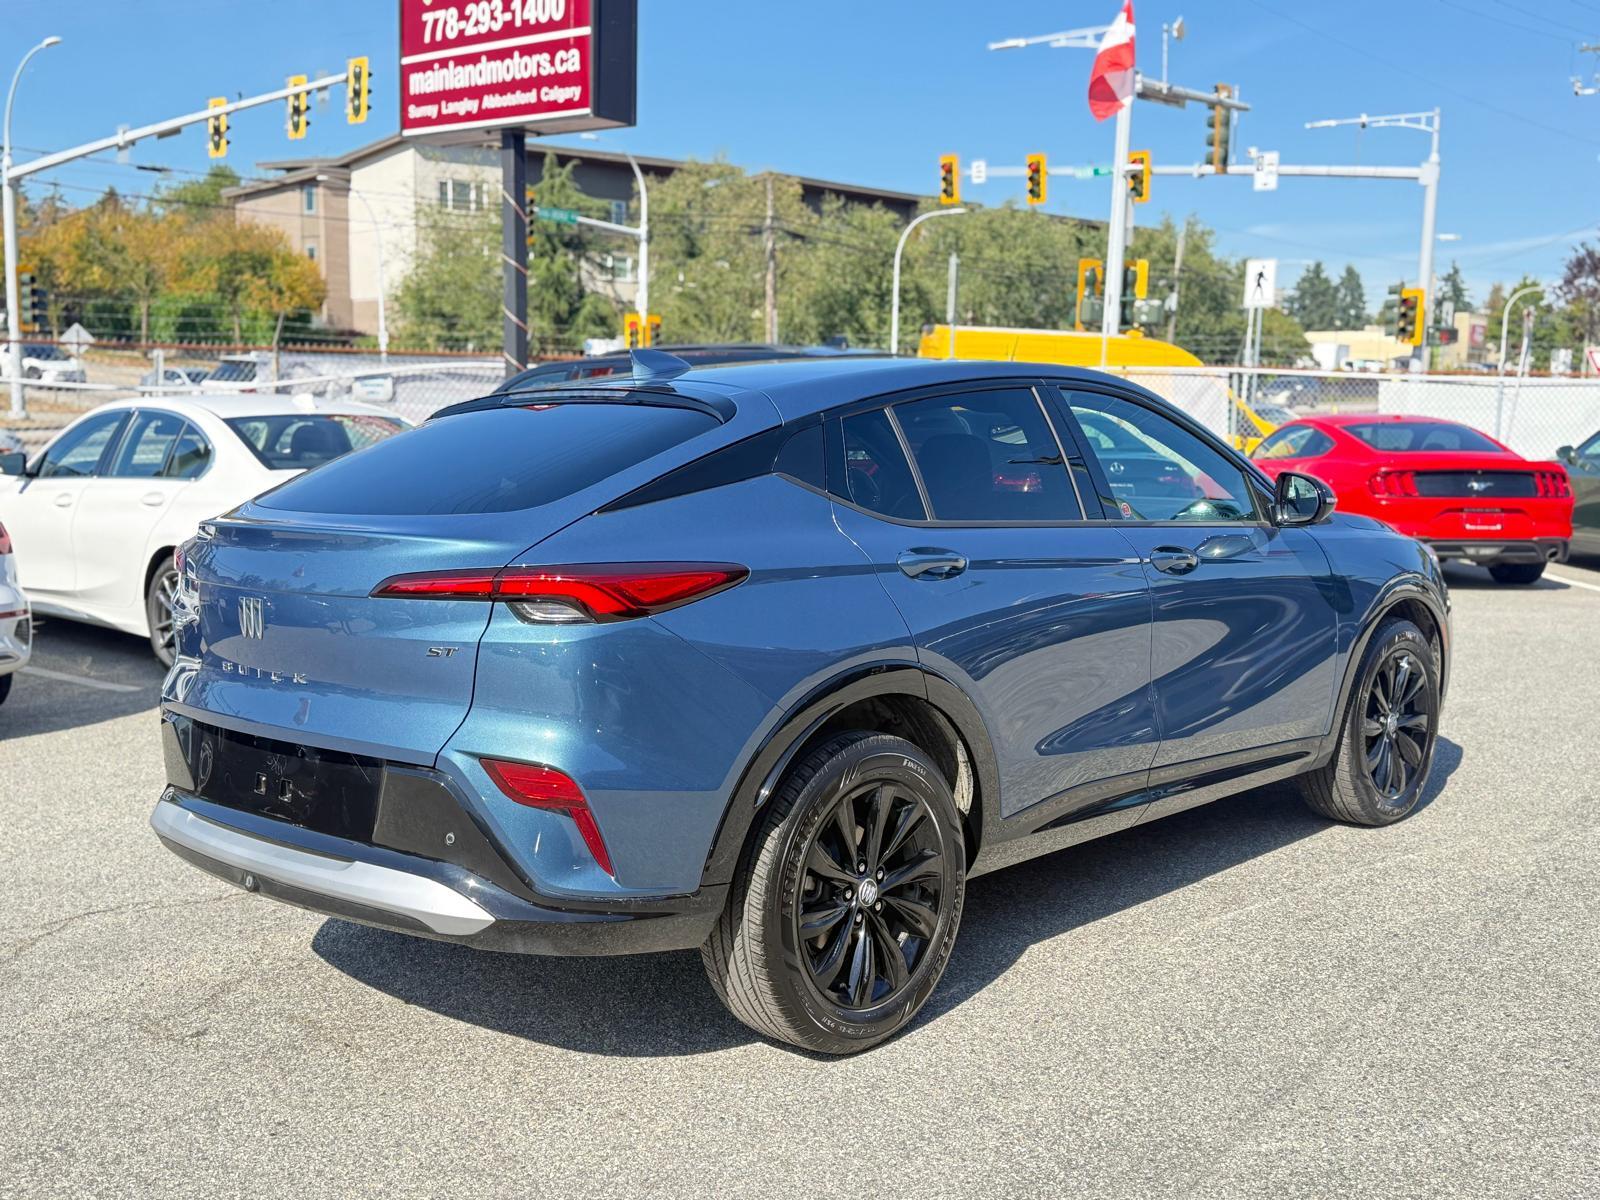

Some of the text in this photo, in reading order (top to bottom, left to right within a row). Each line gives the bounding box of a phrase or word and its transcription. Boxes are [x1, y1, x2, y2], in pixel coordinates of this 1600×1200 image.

[421, 0, 566, 44] 778-293-1400
[408, 48, 581, 96] mainlandmotors.ca
[540, 85, 582, 103] Calgary
[426, 646, 460, 657] ST
[222, 661, 308, 685] BUICK
